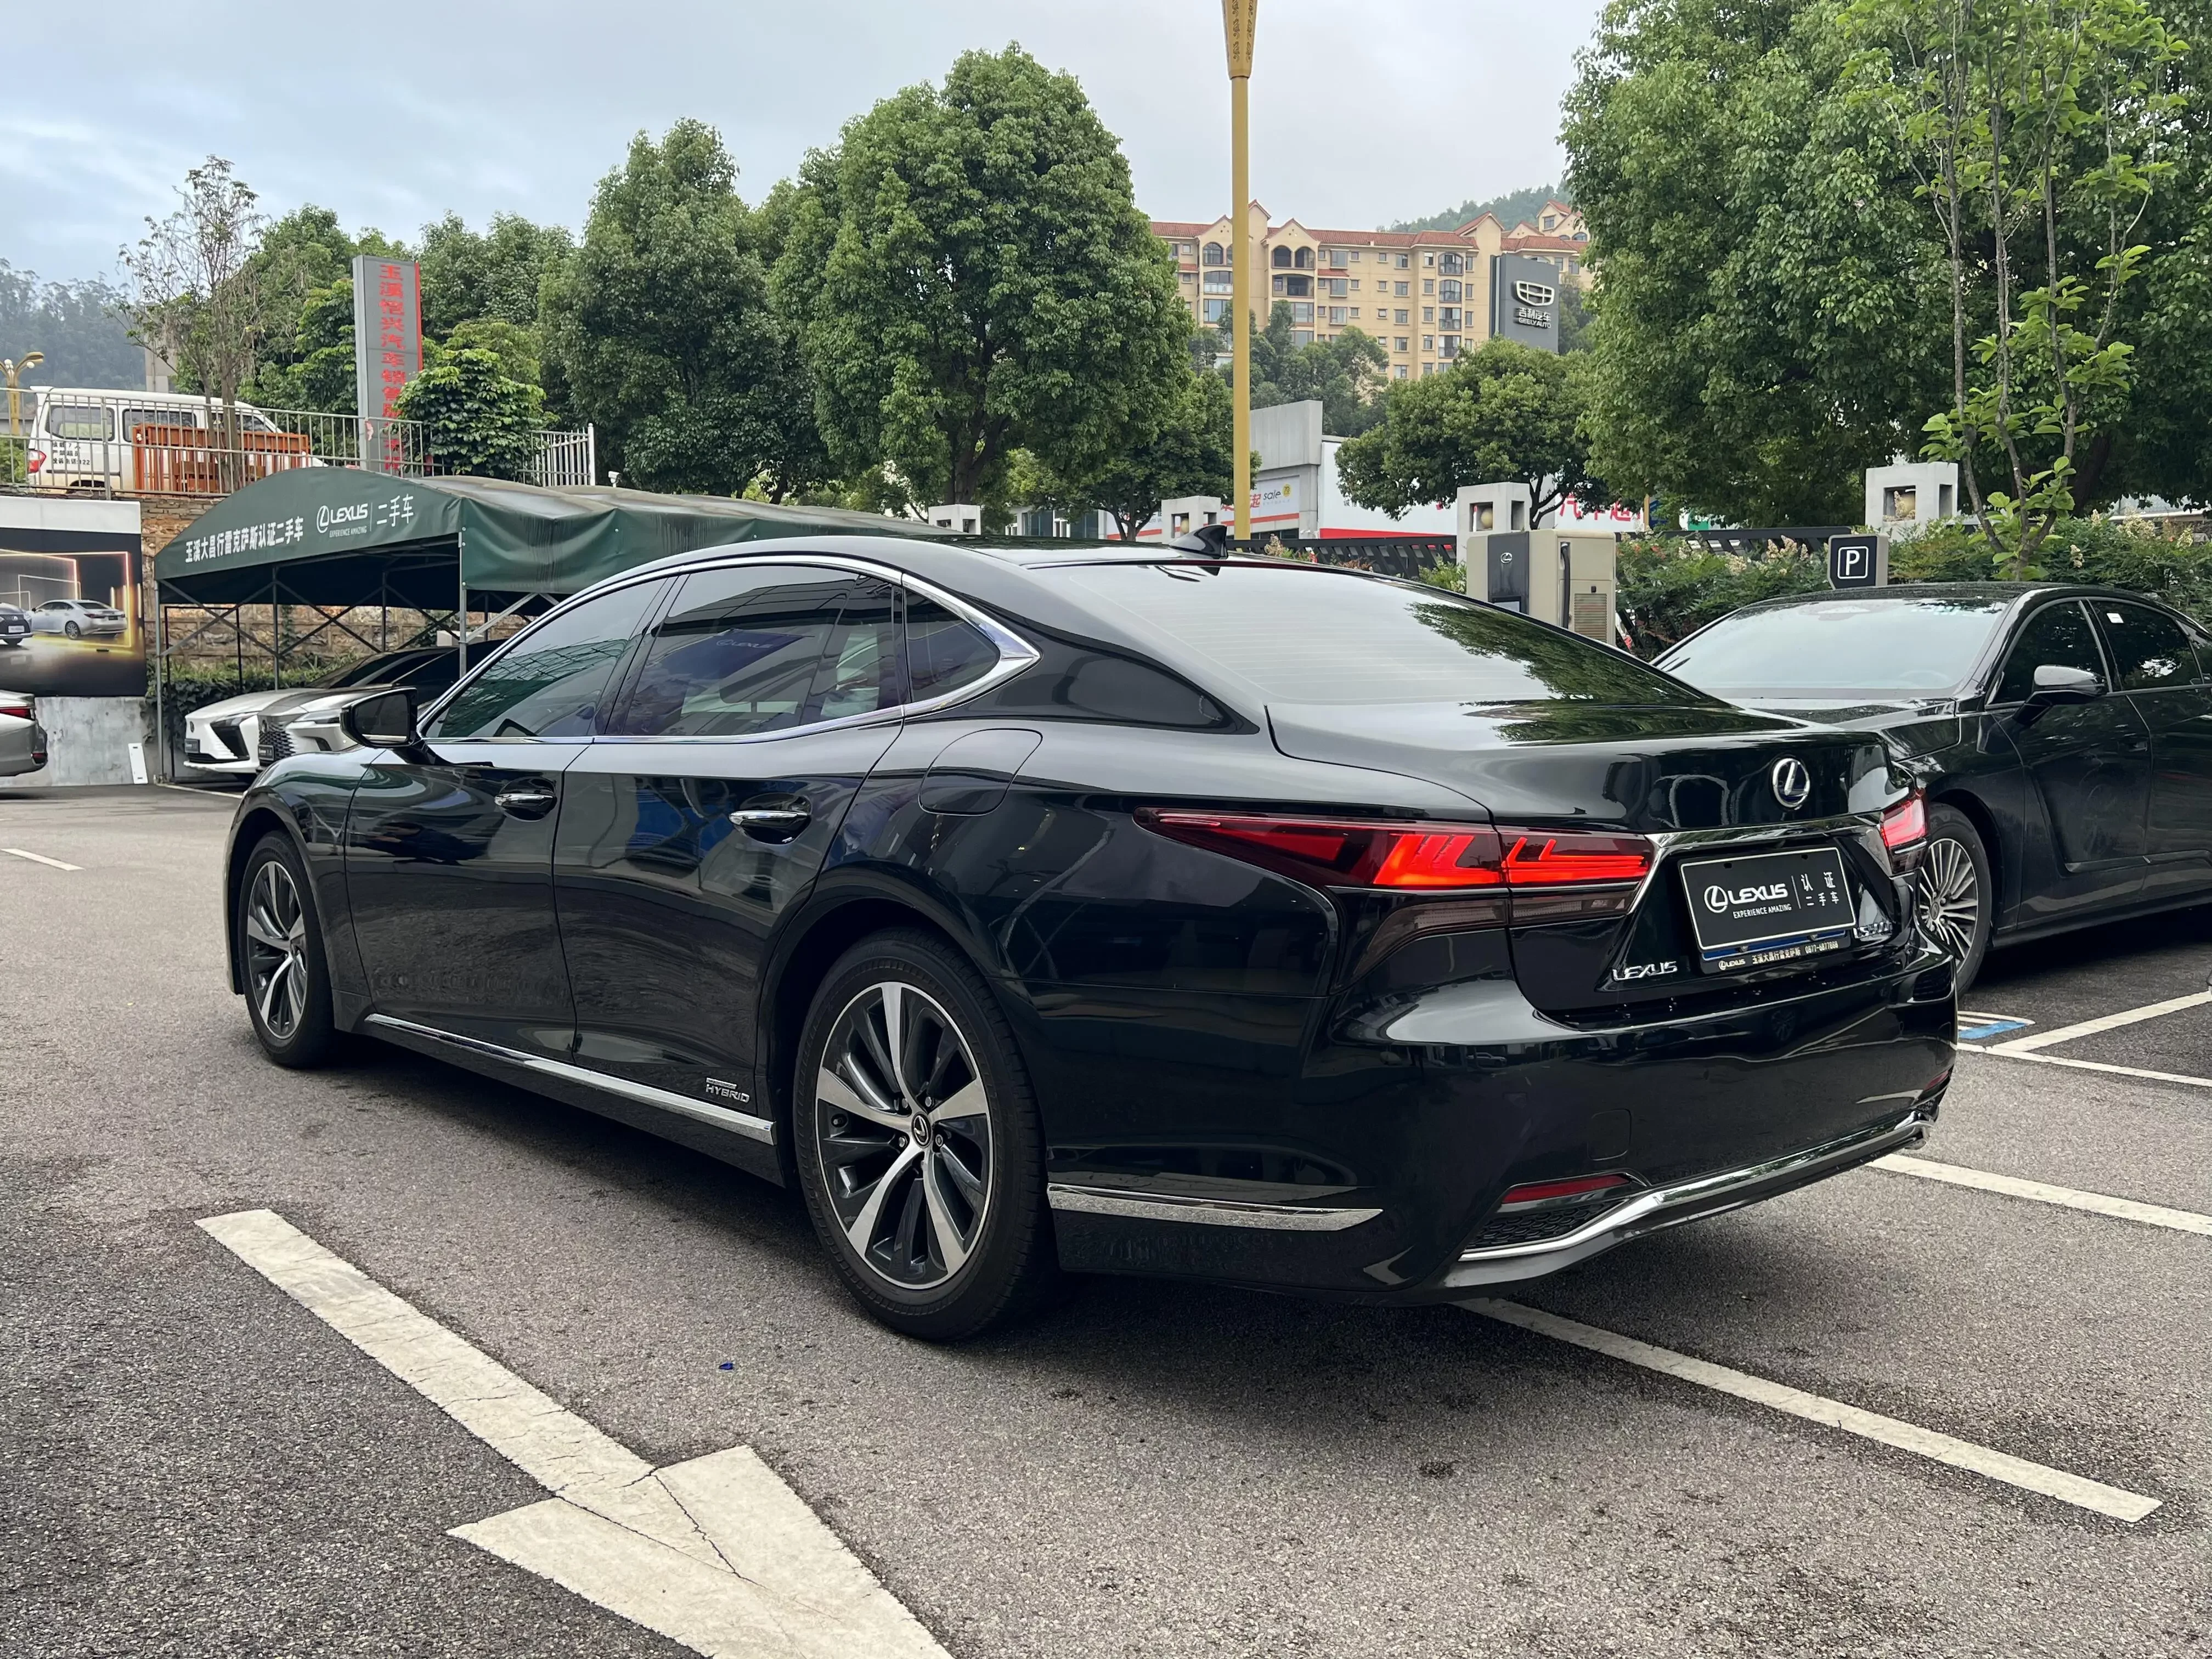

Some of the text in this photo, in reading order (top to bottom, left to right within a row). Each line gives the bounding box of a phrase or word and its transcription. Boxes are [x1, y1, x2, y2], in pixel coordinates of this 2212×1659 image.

[1519, 307, 1551, 321] 吉利汽车
[1519, 317, 1551, 329] GEELY AUTO
[1263, 489, 1281, 500] sale
[330, 503, 368, 523] LEXUS
[377, 493, 414, 527] 二手车
[185, 516, 304, 563] 玉溪大昌行雷克萨斯认证二手车
[329, 526, 367, 538] EXPERIENCE AMAZING
[1846, 550, 1860, 576] P
[1801, 871, 1836, 891] 认证
[1728, 883, 1788, 905] LEXUS
[1805, 891, 1839, 906] 二手车
[1733, 904, 1792, 919] EXPERIENCE AMAZING
[1612, 961, 1678, 981] LEXUS
[1726, 959, 1746, 968] LEXUS
[706, 1084, 750, 1103] HYBRID
